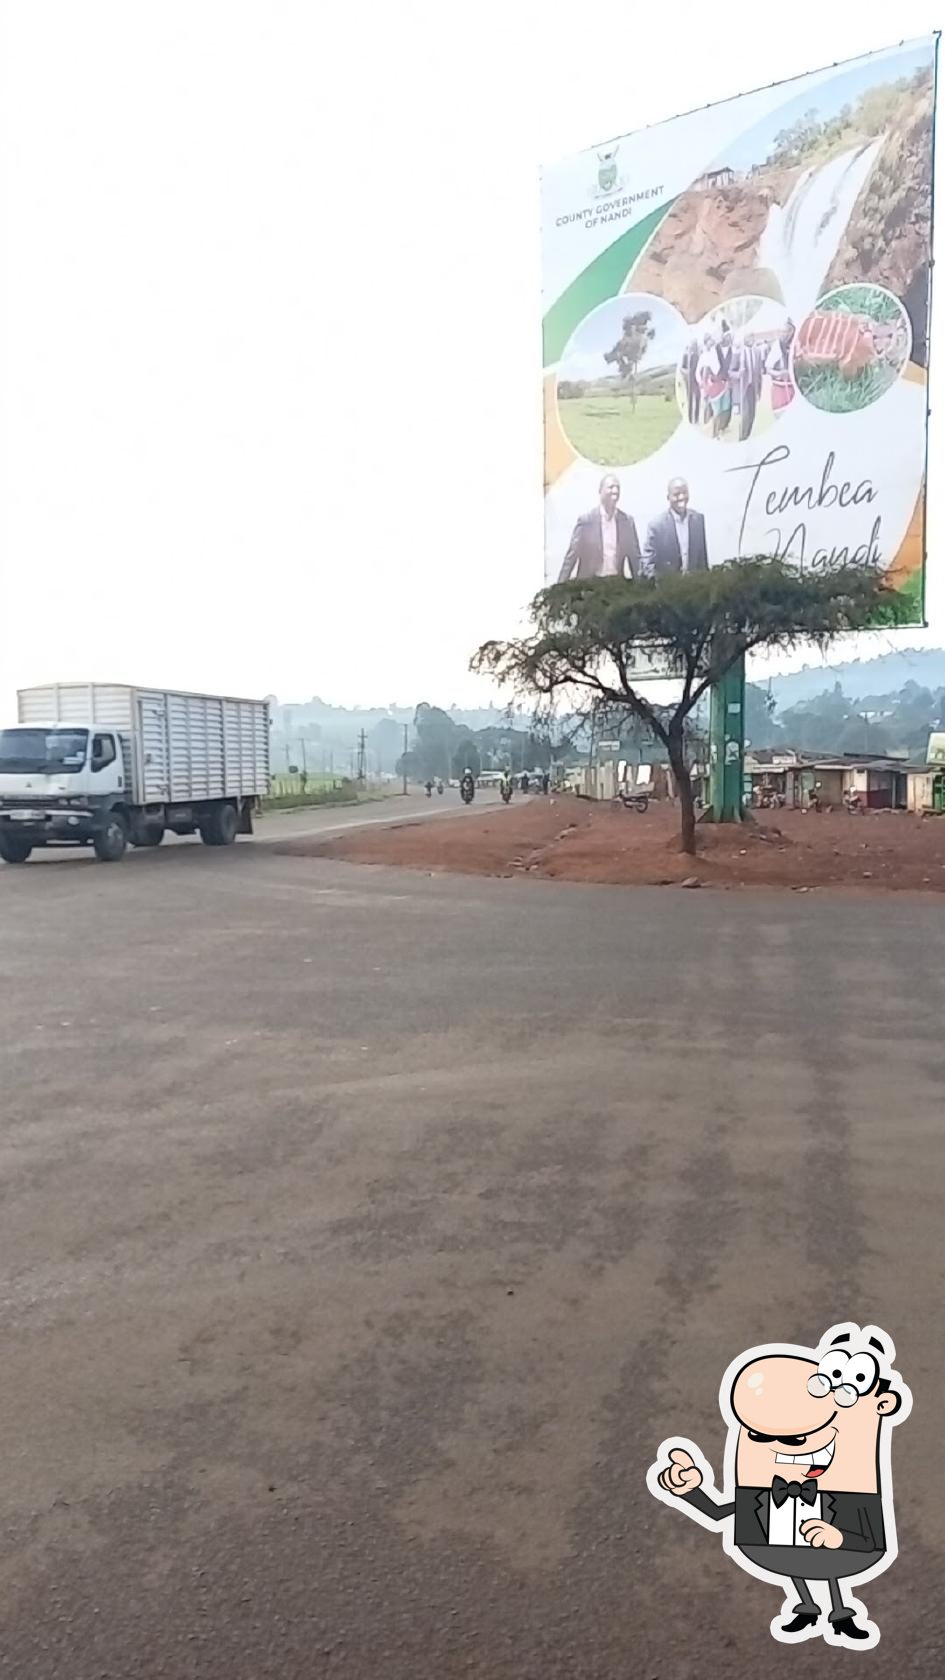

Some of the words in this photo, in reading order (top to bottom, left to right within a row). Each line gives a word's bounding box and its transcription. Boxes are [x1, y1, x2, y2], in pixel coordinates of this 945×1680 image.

[555, 209, 593, 227] COUNTY
[595, 185, 665, 215] GOVERNMENT
[584, 218, 598, 229] OF
[600, 207, 632, 224] NANDI
[723, 444, 879, 558] Tembea
[763, 515, 882, 576] Nandi
